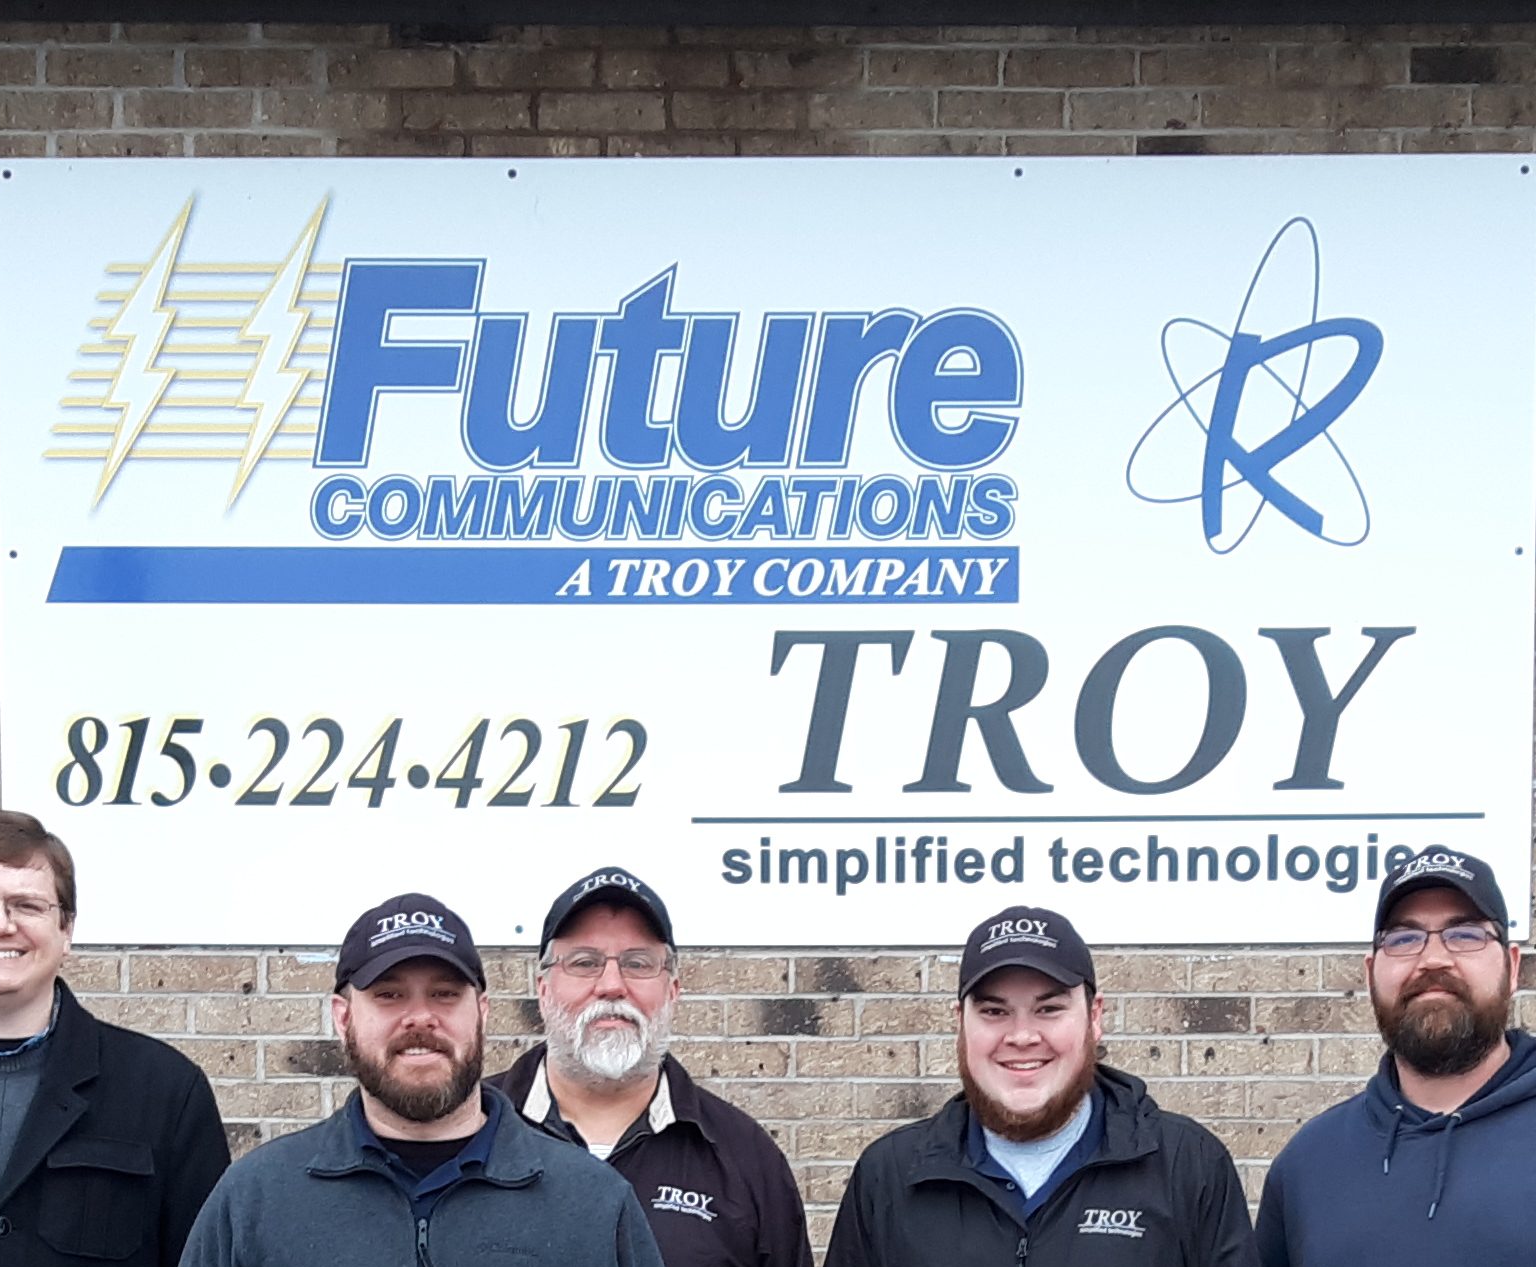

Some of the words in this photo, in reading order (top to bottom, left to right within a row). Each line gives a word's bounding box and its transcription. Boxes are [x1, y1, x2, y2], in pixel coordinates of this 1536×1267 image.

[312, 257, 1024, 472] Future
[310, 474, 1018, 541] COMMUNICATIONS
[555, 558, 592, 597] A
[607, 558, 750, 597] TROY
[753, 558, 1009, 597] COMPANY
[769, 625, 1416, 795] TROY
[721, 836, 1025, 896] simplified
[1048, 833, 1414, 893] technologie
[1406, 852, 1465, 874] TROY
[581, 873, 642, 893] TROY
[376, 911, 445, 933] TROY
[988, 918, 1048, 940] TROY
[657, 1185, 714, 1210] TROY
[1084, 1209, 1143, 1228] TROY
